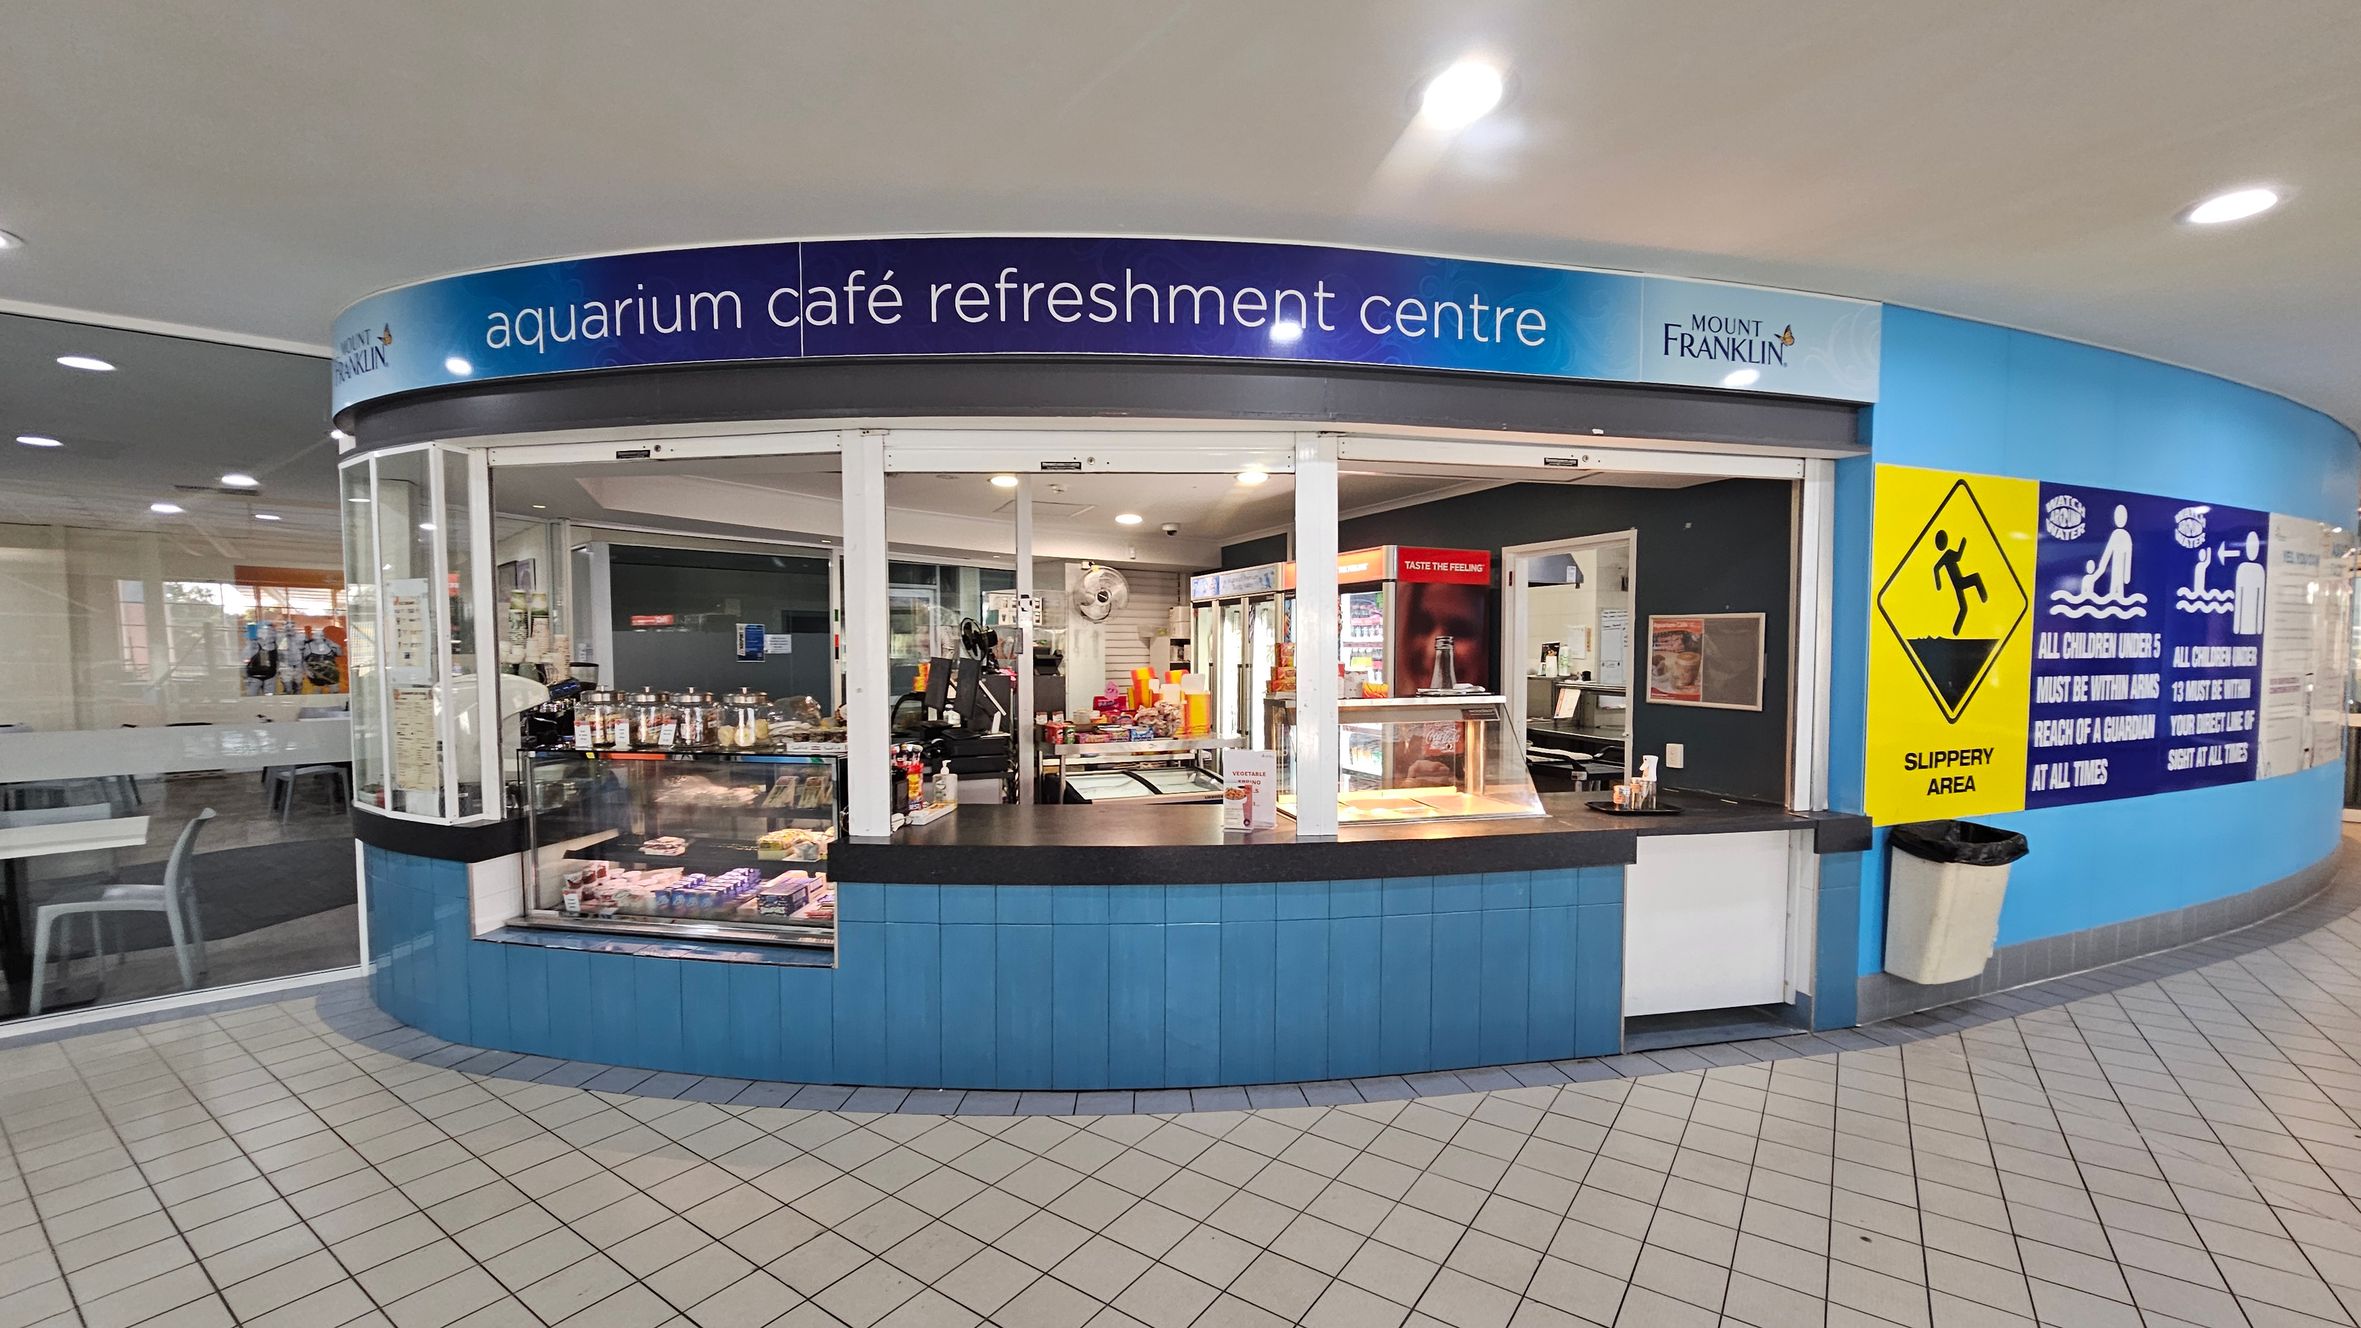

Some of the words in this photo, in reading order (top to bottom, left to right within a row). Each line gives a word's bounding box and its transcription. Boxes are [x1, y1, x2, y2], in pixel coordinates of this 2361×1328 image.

[486, 283, 742, 353] aquarium
[767, 270, 903, 329] café
[929, 267, 1336, 332] refreshment
[1359, 293, 1548, 347] centre
[1691, 314, 1764, 338] MOUNT
[341, 328, 371, 355] MOUNT
[1663, 323, 1785, 366] FRANKLIN
[2045, 494, 2086, 519] WATCH
[2045, 518, 2086, 541] WATER
[1404, 560, 1431, 571] TASTE
[1432, 562, 1449, 572] THE
[1449, 562, 1484, 573] FEELING
[2038, 631, 2061, 659] ALL
[2062, 631, 2118, 659] CHILDREN
[2118, 632, 2153, 659] UNDER
[2153, 633, 2162, 659] 5
[2172, 645, 2191, 668] ALL
[2191, 645, 2232, 668] CHILDREN
[2232, 646, 2258, 667] UNDER
[2036, 675, 2072, 704] MUST
[2072, 675, 2089, 702] BE
[2090, 674, 2130, 702] WITHIN
[2130, 673, 2160, 700] ARMS
[2171, 680, 2185, 703] 13
[2185, 680, 2212, 702] MUST
[2211, 679, 2223, 701] BE
[2033, 718, 2075, 748] REACH
[2076, 717, 2092, 745] OF
[2092, 717, 2102, 744] A
[2103, 713, 2157, 743] GUARDIAN
[2170, 714, 2196, 737] YOUR
[2196, 711, 2227, 735] DIRECT
[2226, 710, 2244, 732] LINE
[2244, 709, 2256, 731] OF
[1904, 747, 1995, 772] SLIPPERY
[2167, 747, 2196, 772] SIGHT
[2196, 746, 2208, 768] AT
[2208, 745, 2223, 767] ALL
[2224, 742, 2249, 765] TIMES
[1926, 775, 1976, 796] AREA
[2031, 762, 2049, 792] AT
[2049, 761, 2071, 790] ALL
[2073, 758, 2109, 787] TIMES
